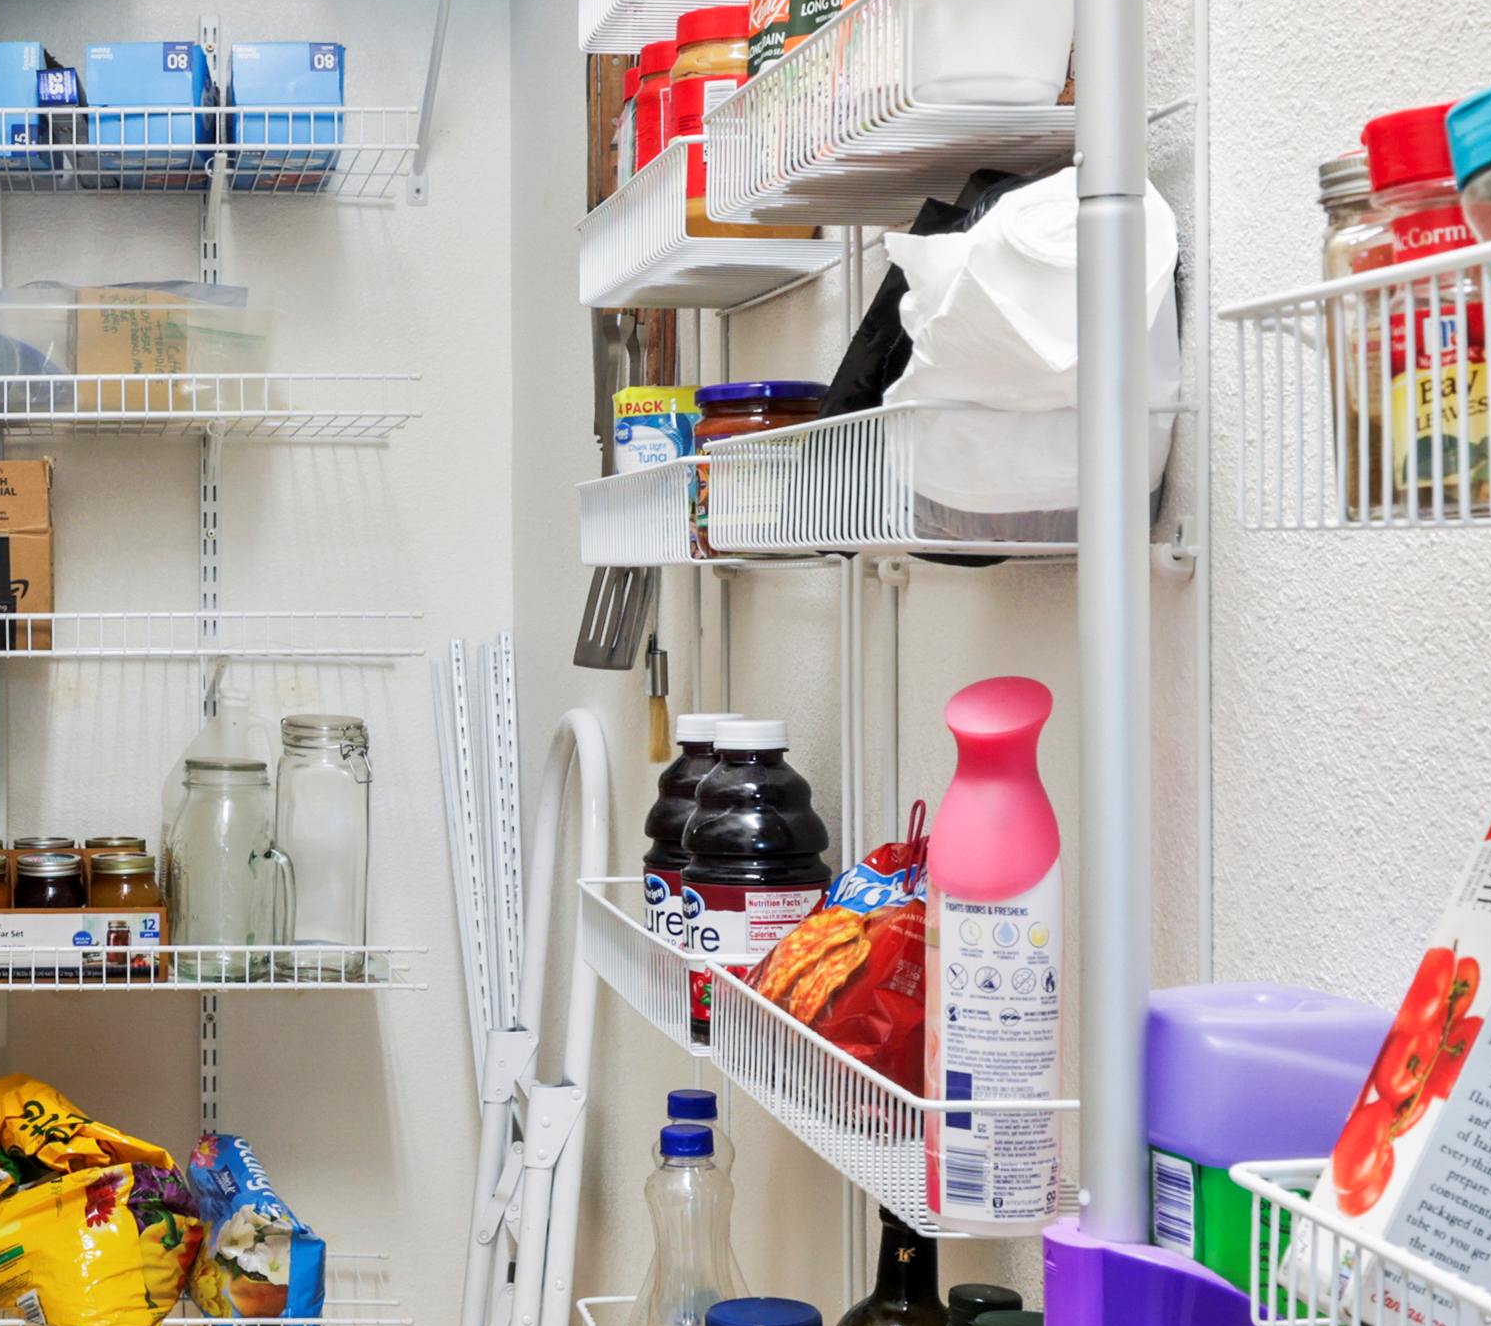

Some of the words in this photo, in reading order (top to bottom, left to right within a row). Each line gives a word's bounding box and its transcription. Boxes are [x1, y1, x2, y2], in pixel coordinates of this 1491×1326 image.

[167, 53, 188, 70] 80
[313, 53, 335, 70] 80
[1418, 366, 1479, 408] Bay
[625, 400, 664, 415] PACK
[638, 452, 668, 464] Tuna
[748, 898, 780, 908] Nutrition
[782, 898, 801, 907] Facts
[966, 904, 986, 915] ODORS
[988, 906, 993, 915] &
[994, 906, 1029, 916] FRESHENS
[142, 918, 156, 930] 12
[10, 929, 24, 938] Set
[749, 929, 777, 939] Calories
[1467, 1111, 1489, 1132] and
[1456, 1129, 1472, 1145] of
[1419, 1198, 1472, 1233] packaged
[1432, 1227, 1448, 1242] so
[1448, 1235, 1471, 1257] you
[1471, 1245, 1491, 1263] get
[1407, 1236, 1428, 1255] the
[1428, 1247, 1472, 1276] amount
